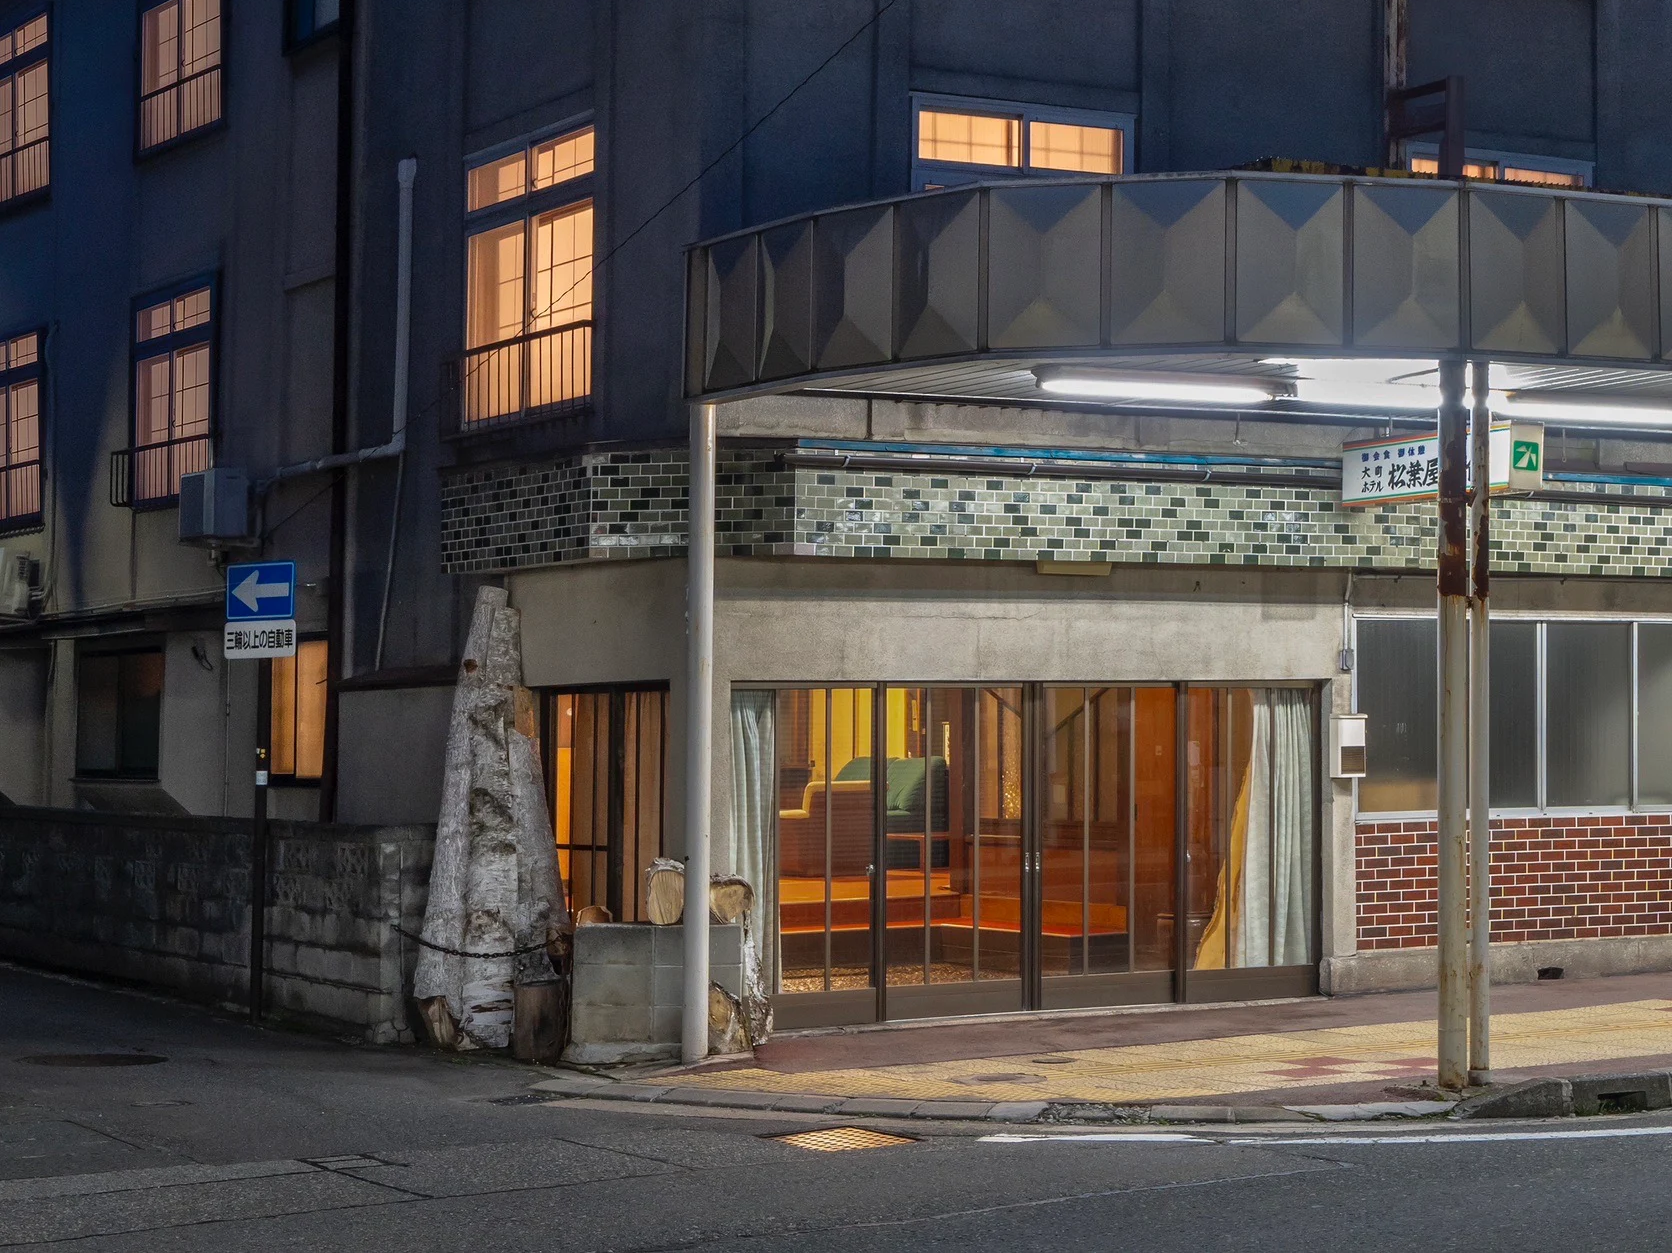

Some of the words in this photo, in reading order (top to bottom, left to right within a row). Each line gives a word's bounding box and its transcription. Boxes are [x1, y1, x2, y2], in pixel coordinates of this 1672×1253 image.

[1361, 465, 1383, 479] 大町
[1361, 480, 1384, 493] ホテル
[226, 628, 293, 650] 三輪以上の自動車
